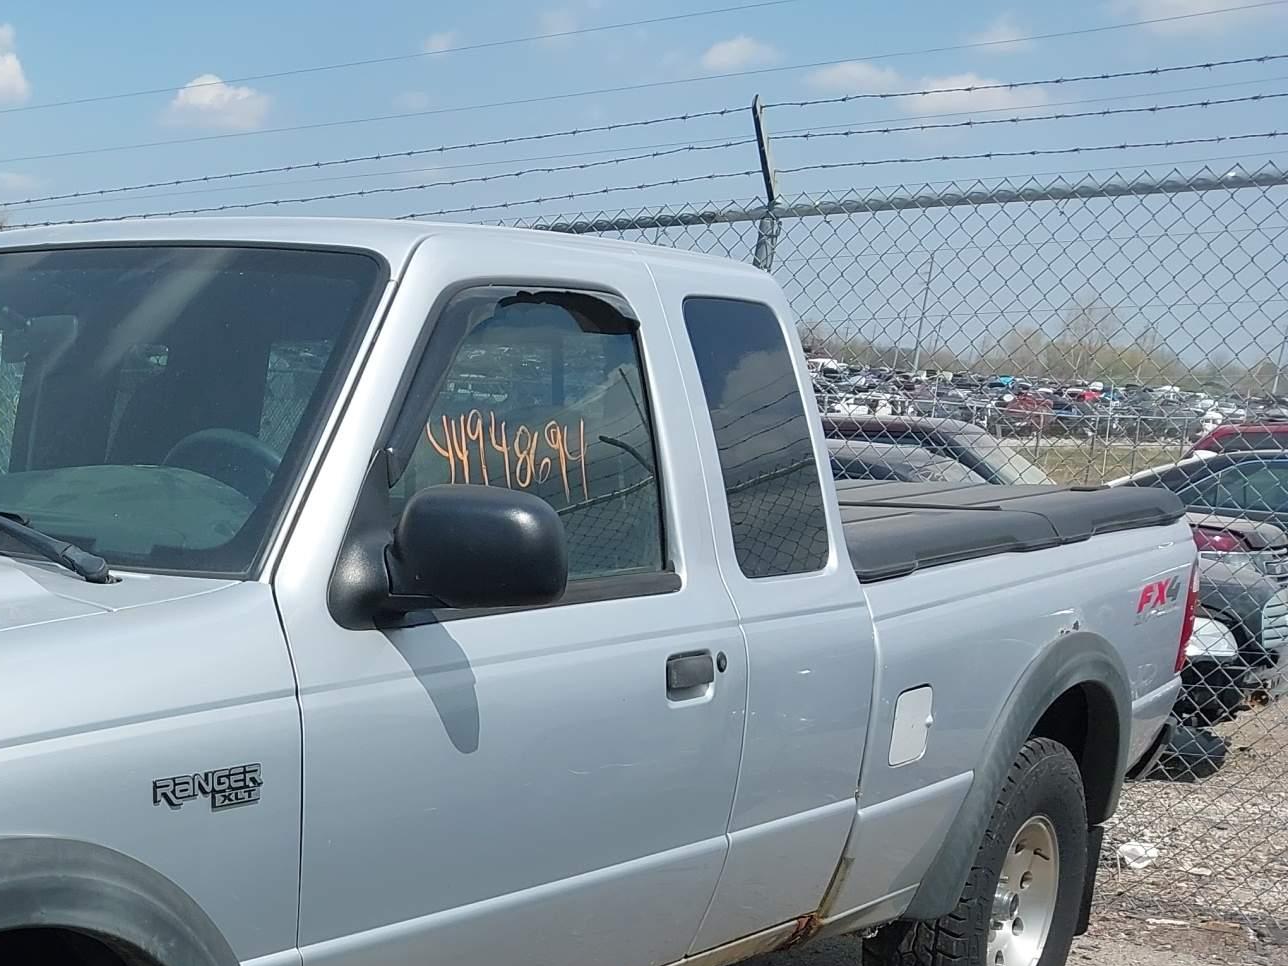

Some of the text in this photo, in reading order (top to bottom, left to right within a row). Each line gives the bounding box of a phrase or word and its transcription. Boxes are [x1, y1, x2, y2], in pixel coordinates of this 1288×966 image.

[426, 408, 589, 503] 44948694
[1136, 575, 1182, 614] FX4
[152, 762, 263, 808] RANGER
[220, 788, 258, 805] XLT
